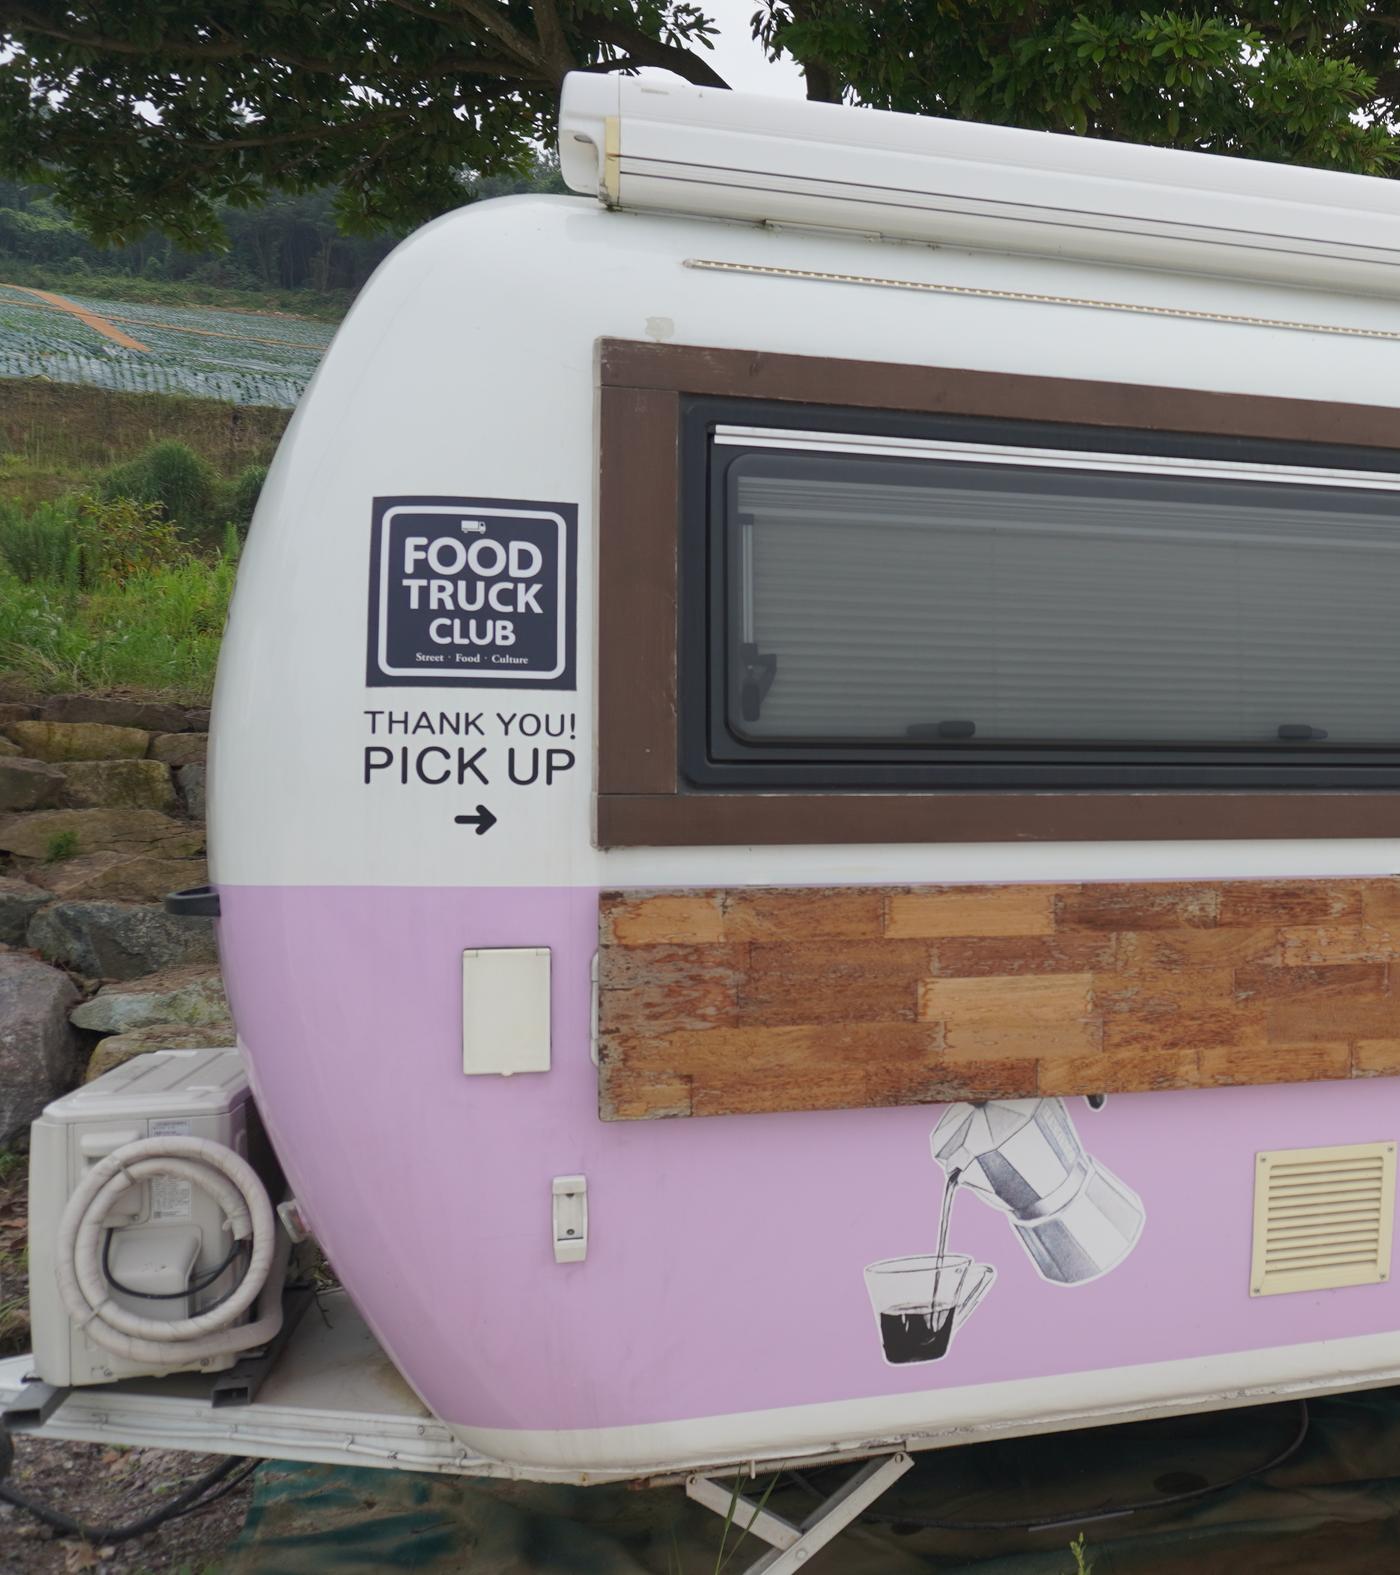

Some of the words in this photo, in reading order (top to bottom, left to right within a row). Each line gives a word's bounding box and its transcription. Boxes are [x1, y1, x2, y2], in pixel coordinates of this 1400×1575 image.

[404, 536, 543, 578] FOOD
[402, 579, 544, 614] TRUCK
[429, 617, 516, 646] CLUB
[415, 652, 444, 662] Street
[455, 654, 480, 663] Food
[491, 654, 529, 664] Culture
[363, 710, 485, 736] THANK
[496, 712, 576, 740] YOU!
[364, 746, 489, 785] PICK
[508, 747, 576, 786] UP
